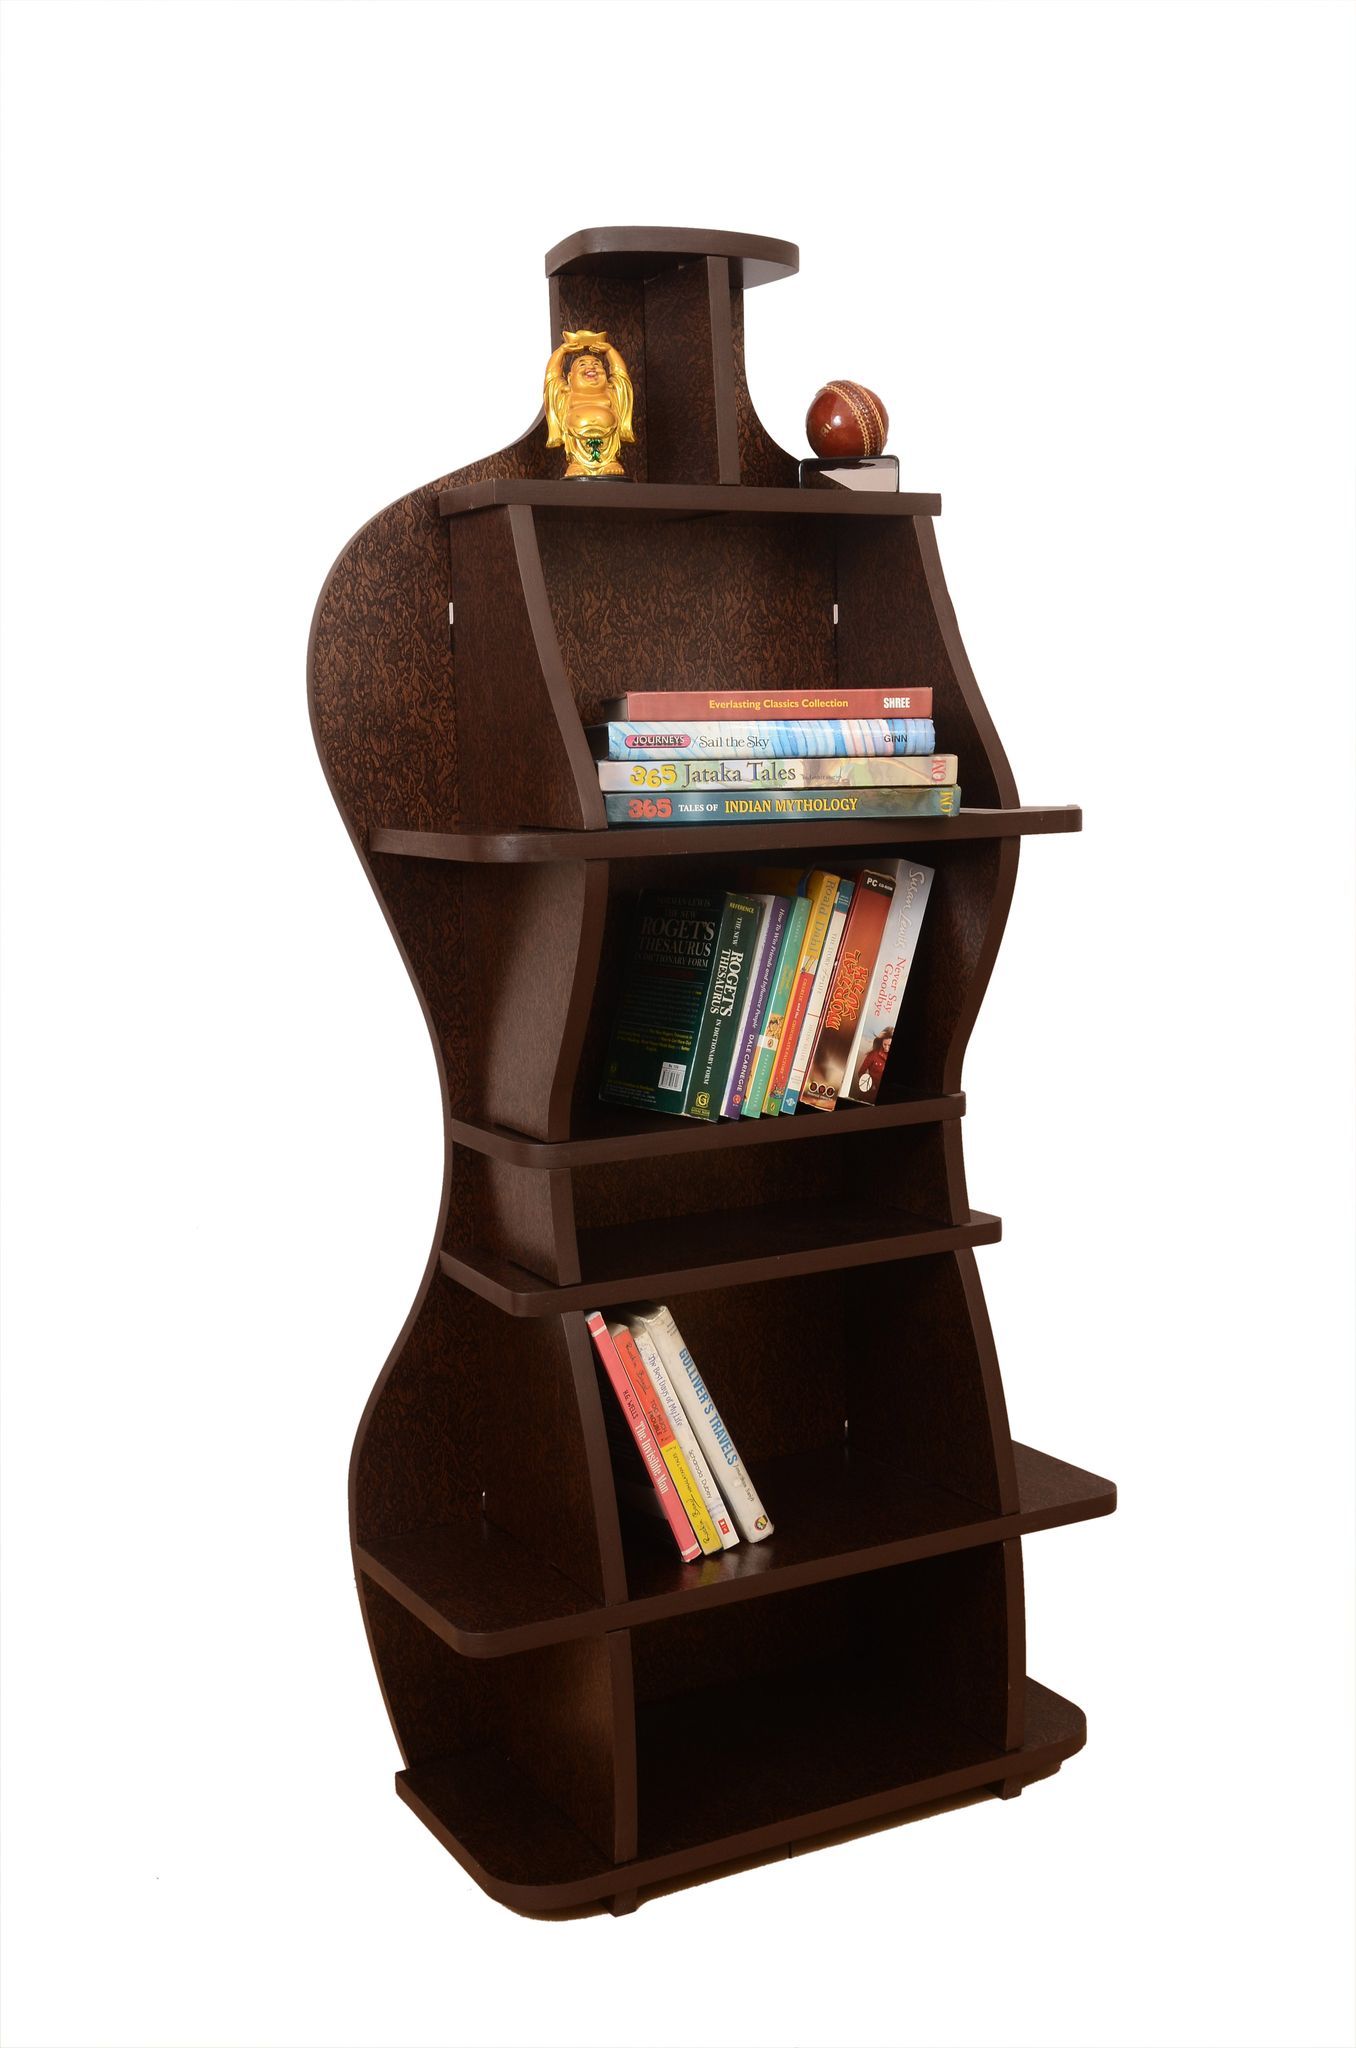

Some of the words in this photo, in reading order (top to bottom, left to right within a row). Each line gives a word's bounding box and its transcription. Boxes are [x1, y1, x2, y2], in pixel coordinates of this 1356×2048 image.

[709, 699, 761, 710] Everlasting
[763, 699, 799, 708] Classics
[801, 698, 849, 708] Collection
[883, 697, 911, 709] SHREE
[632, 735, 685, 746] JOURNEYS
[726, 735, 745, 747] the
[747, 735, 769, 750] Sky
[883, 735, 908, 743] GINN
[629, 763, 677, 788] 365
[681, 762, 743, 788] Jataka
[746, 761, 796, 781] Tales
[931, 759, 947, 783] OM
[628, 798, 673, 819] 365
[678, 804, 704, 812] TALES
[706, 803, 718, 811] OF
[725, 799, 773, 814] INDIAN
[775, 798, 858, 812] MYTHOLOGY
[940, 790, 954, 813] OM
[866, 877, 878, 887] PC
[901, 868, 925, 911] Susan
[729, 902, 755, 914] REFERENCE
[818, 880, 835, 916] Roald
[734, 916, 743, 930] THE
[777, 908, 786, 922] How
[640, 917, 715, 941] ROGET'S
[732, 930, 740, 946] NEW
[775, 924, 782, 932] To
[809, 921, 825, 953] Dahl
[894, 909, 912, 950] Lewis
[639, 936, 712, 957] THESAURUS
[772, 932, 780, 946] Win
[687, 958, 708, 968] FORM
[766, 945, 776, 967] Friends
[710, 948, 732, 1014] THESAURUS
[720, 950, 744, 1017] ROGET'S
[890, 956, 907, 991] Never
[757, 980, 768, 1009] Influence
[874, 963, 894, 1017] Goodbye
[884, 993, 897, 1014] Say
[715, 1019, 722, 1027] IN
[752, 1008, 761, 1029] People
[708, 1026, 721, 1065] DICTIONARY
[745, 1034, 755, 1053] DALE
[703, 1066, 712, 1085] FORM
[737, 1054, 750, 1092] CARNEGIE
[648, 1352, 657, 1367] The
[653, 1366, 663, 1382] Best
[659, 1380, 669, 1397] Days
[665, 1396, 673, 1404] of
[669, 1402, 677, 1416] My
[673, 1412, 683, 1426] Life
[627, 1400, 639, 1420] WELLS
[679, 1347, 714, 1415] GULLIVER'S
[708, 1413, 738, 1466] TRAVELS
[635, 1420, 647, 1441] The
[641, 1438, 662, 1477] Invisible
[656, 1473, 669, 1495] Man
